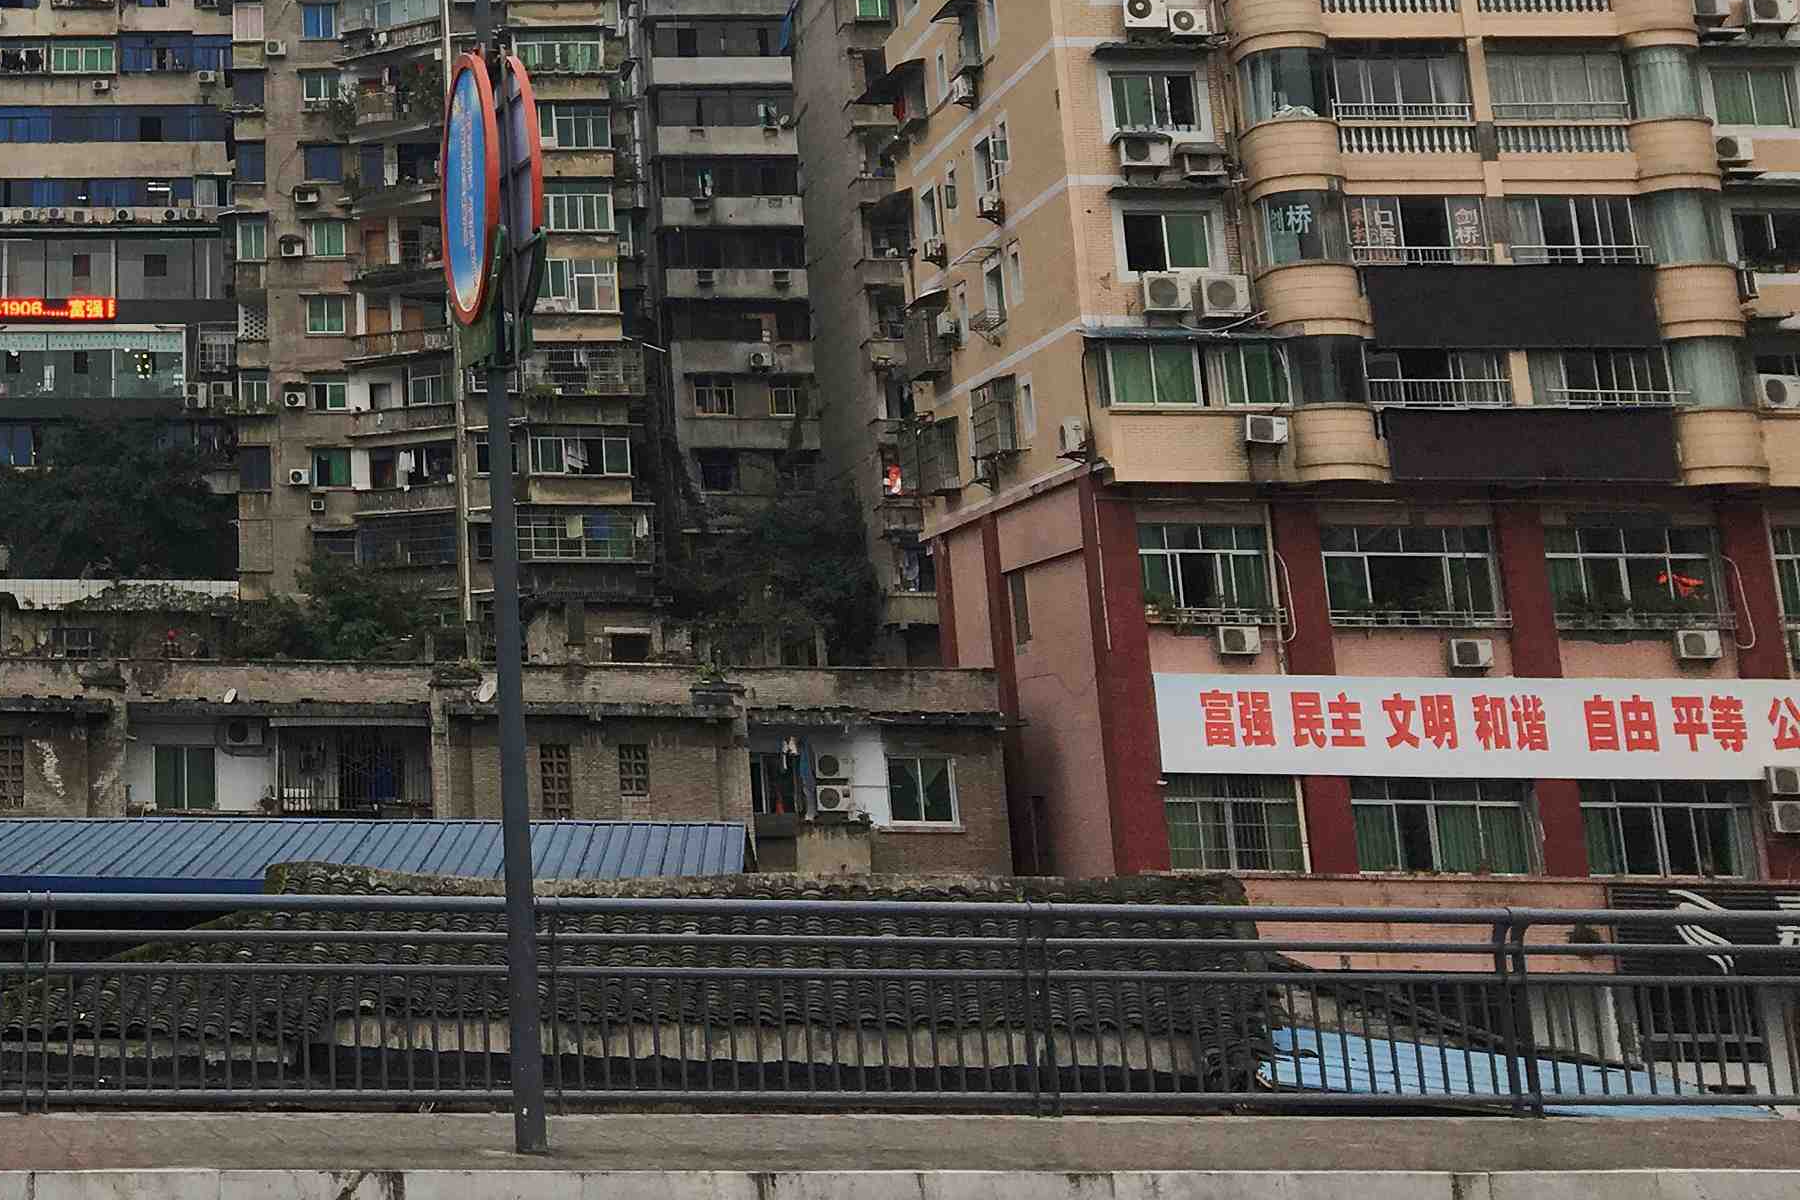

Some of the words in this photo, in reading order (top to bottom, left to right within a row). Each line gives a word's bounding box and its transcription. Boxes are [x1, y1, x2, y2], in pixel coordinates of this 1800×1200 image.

[1200, 689, 1277, 748] 富强
[1290, 691, 1367, 749] 民主
[1382, 692, 1458, 750] 文明
[1472, 694, 1550, 751] 和谐
[1583, 694, 1660, 752] 自由
[1671, 695, 1748, 752] 平等
